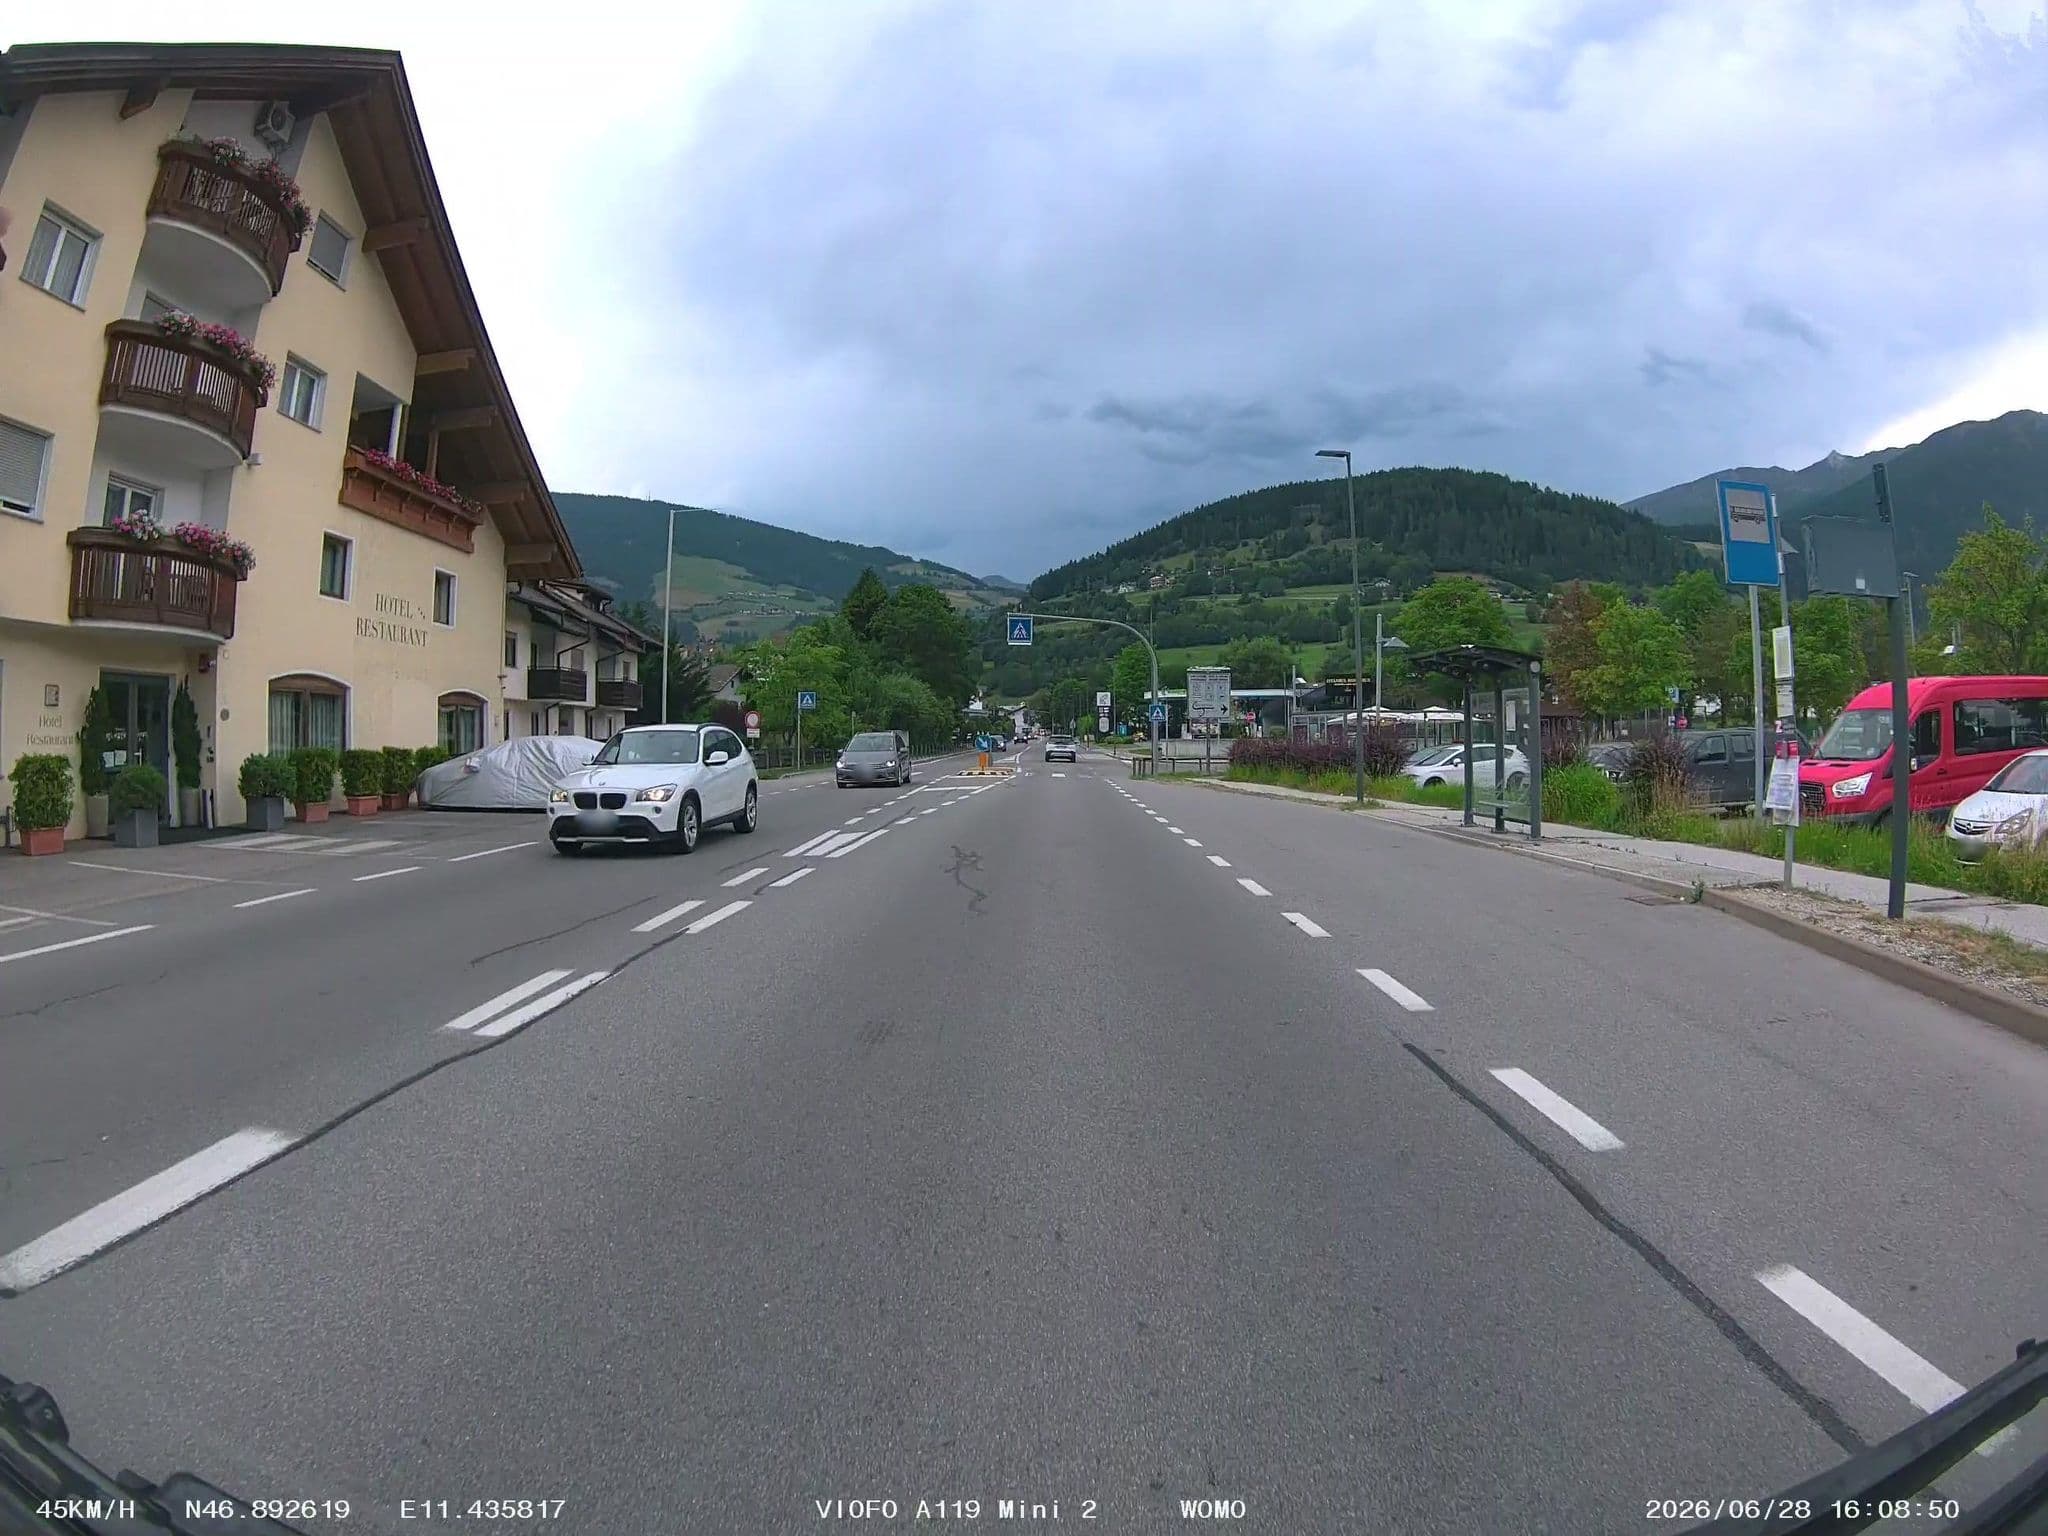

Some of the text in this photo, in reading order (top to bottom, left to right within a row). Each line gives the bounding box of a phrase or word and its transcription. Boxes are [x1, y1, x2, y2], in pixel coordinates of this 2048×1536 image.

[375, 593, 414, 619] HOTEL
[356, 616, 428, 647] RESTAURANT
[39, 714, 62, 729] Hotel
